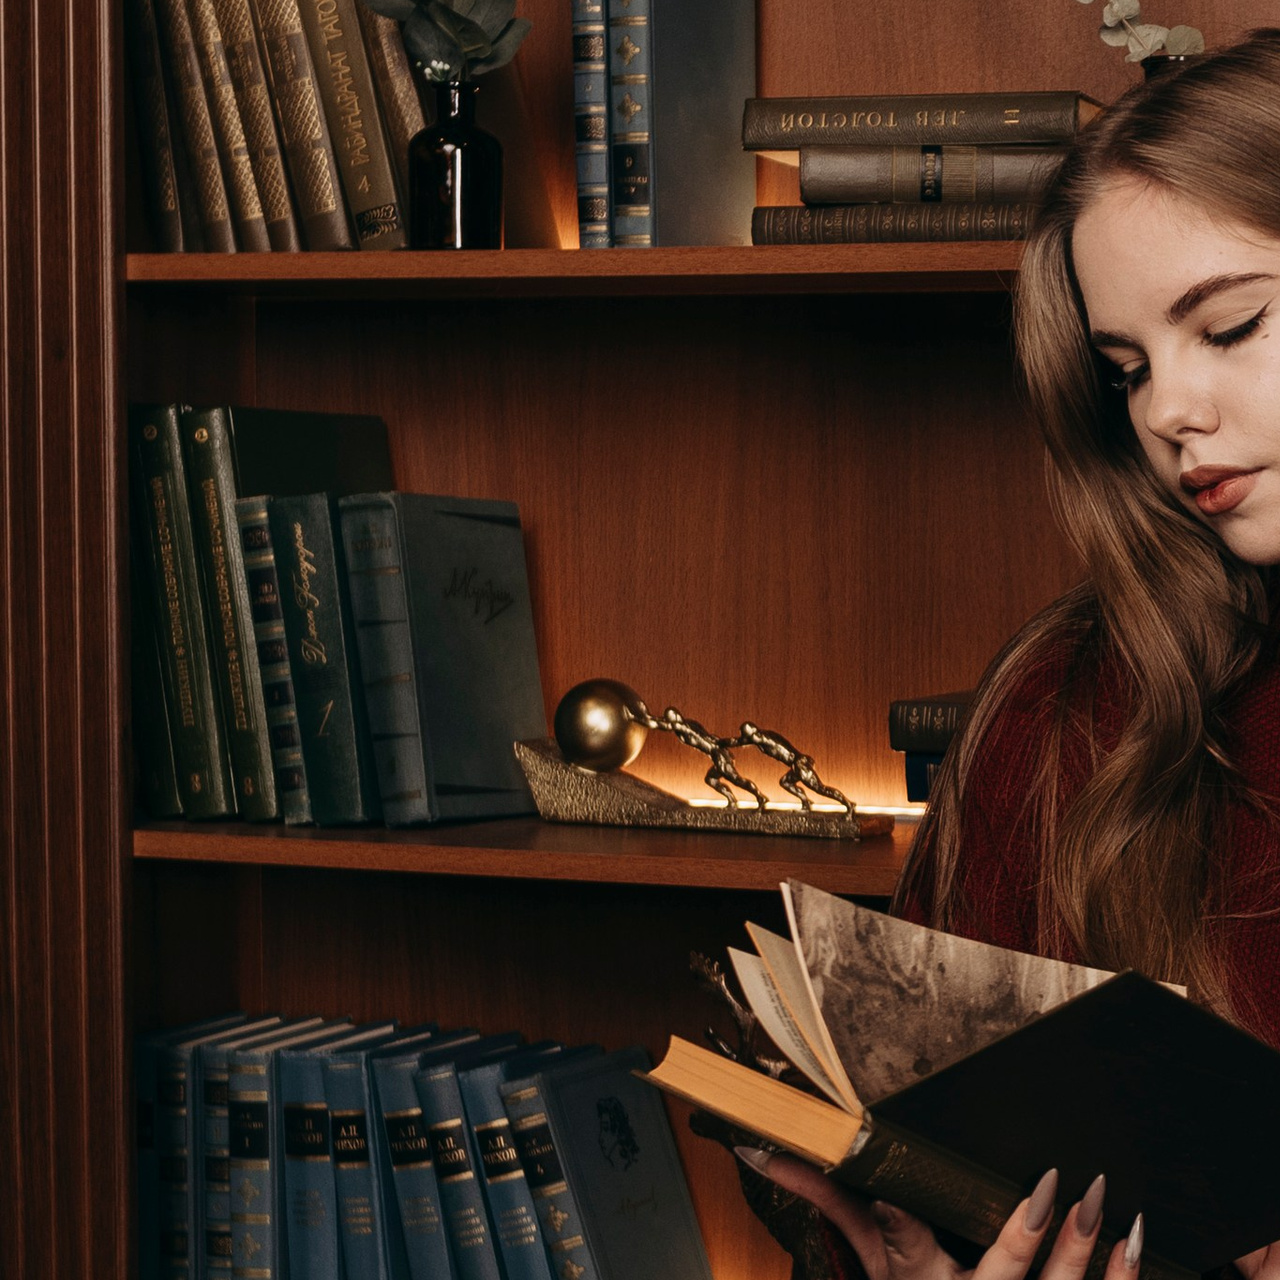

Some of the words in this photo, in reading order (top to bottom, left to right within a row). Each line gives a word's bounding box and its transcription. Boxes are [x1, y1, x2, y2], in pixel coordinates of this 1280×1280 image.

[326, 50, 372, 168] РАБИНДРАНАТ
[780, 111, 898, 133] ТОЛСТОЙ
[916, 109, 968, 129] ЛЕВ
[358, 178, 373, 195] 4
[301, 609, 327, 664] Джон
[316, 699, 334, 737] 1
